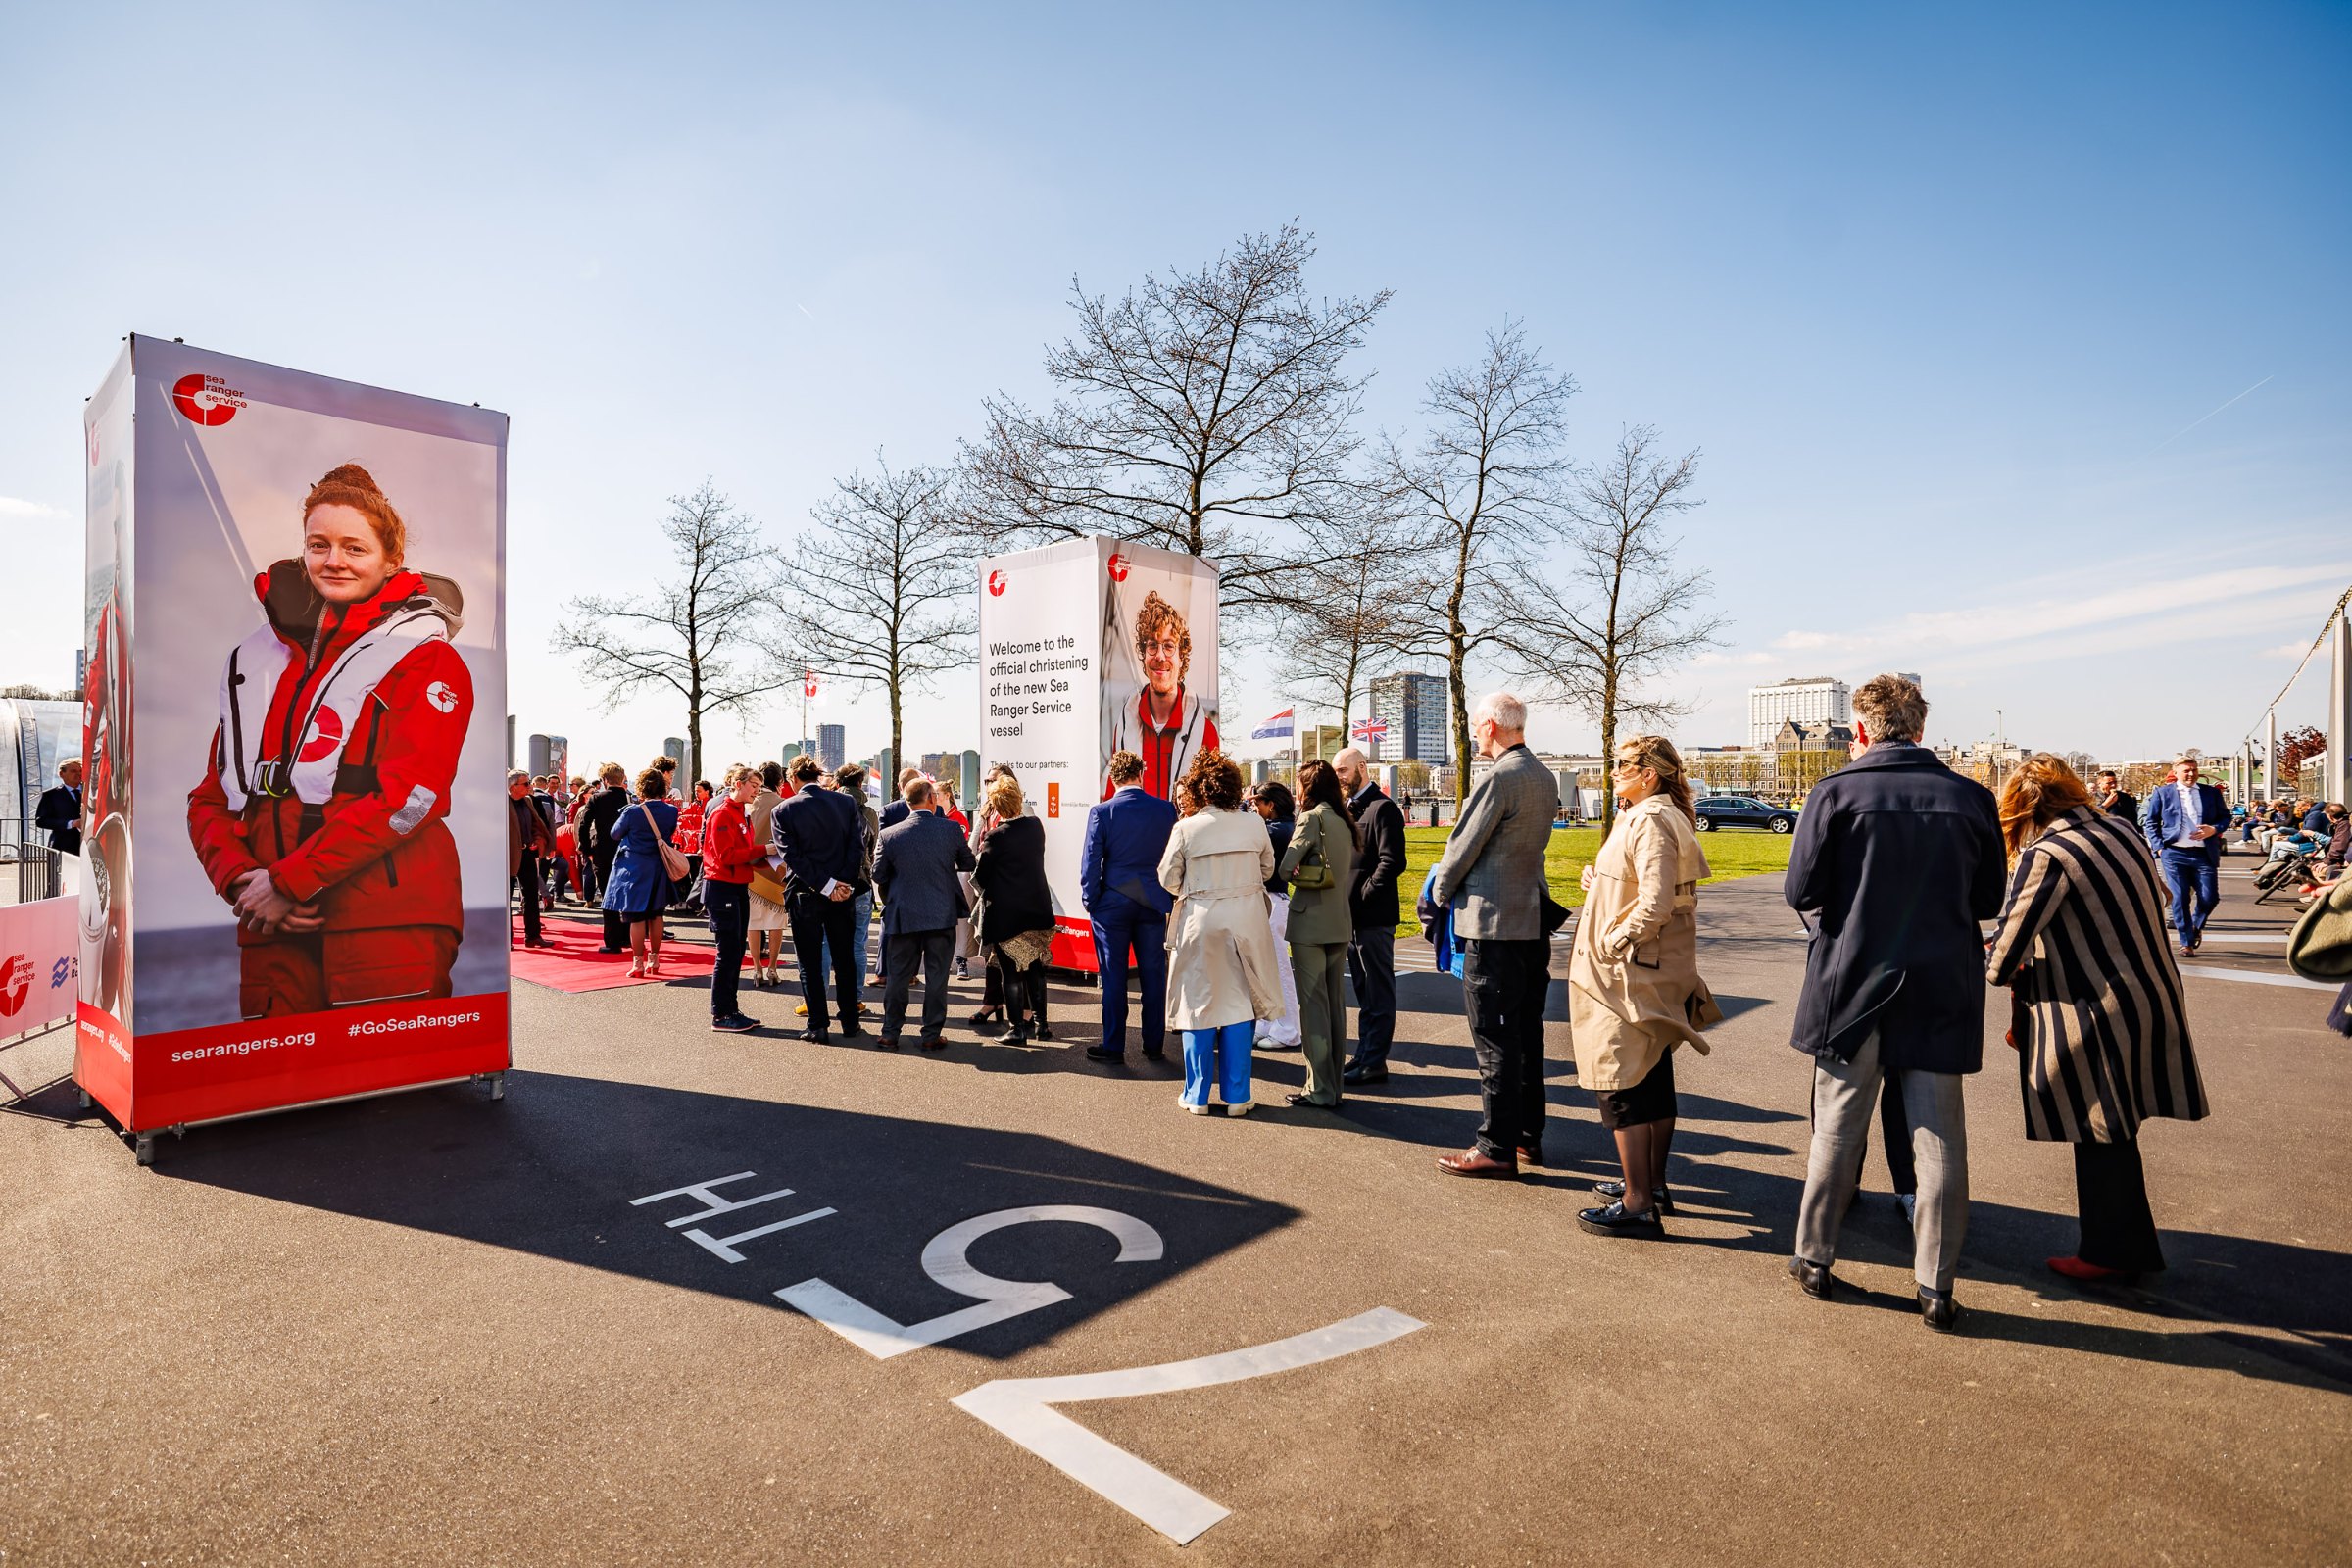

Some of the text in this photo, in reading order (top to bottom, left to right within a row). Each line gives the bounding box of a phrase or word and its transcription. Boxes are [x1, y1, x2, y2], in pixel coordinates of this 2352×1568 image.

[206, 374, 225, 385] sea
[206, 384, 245, 398] ranger
[205, 394, 247, 408] service
[990, 636, 1075, 657] Welcome to the
[990, 655, 1089, 676] official christening
[990, 678, 1069, 697] of the new Sea
[990, 700, 1071, 721] Ranger Service
[990, 722, 1023, 737] vessel
[1039, 760, 1068, 770] partners:
[14, 953, 25, 962] sea
[14, 961, 34, 973] ranger
[13, 972, 35, 985] service
[348, 1010, 481, 1038] #GoSeaRangers
[172, 1030, 316, 1062] searangers.org
